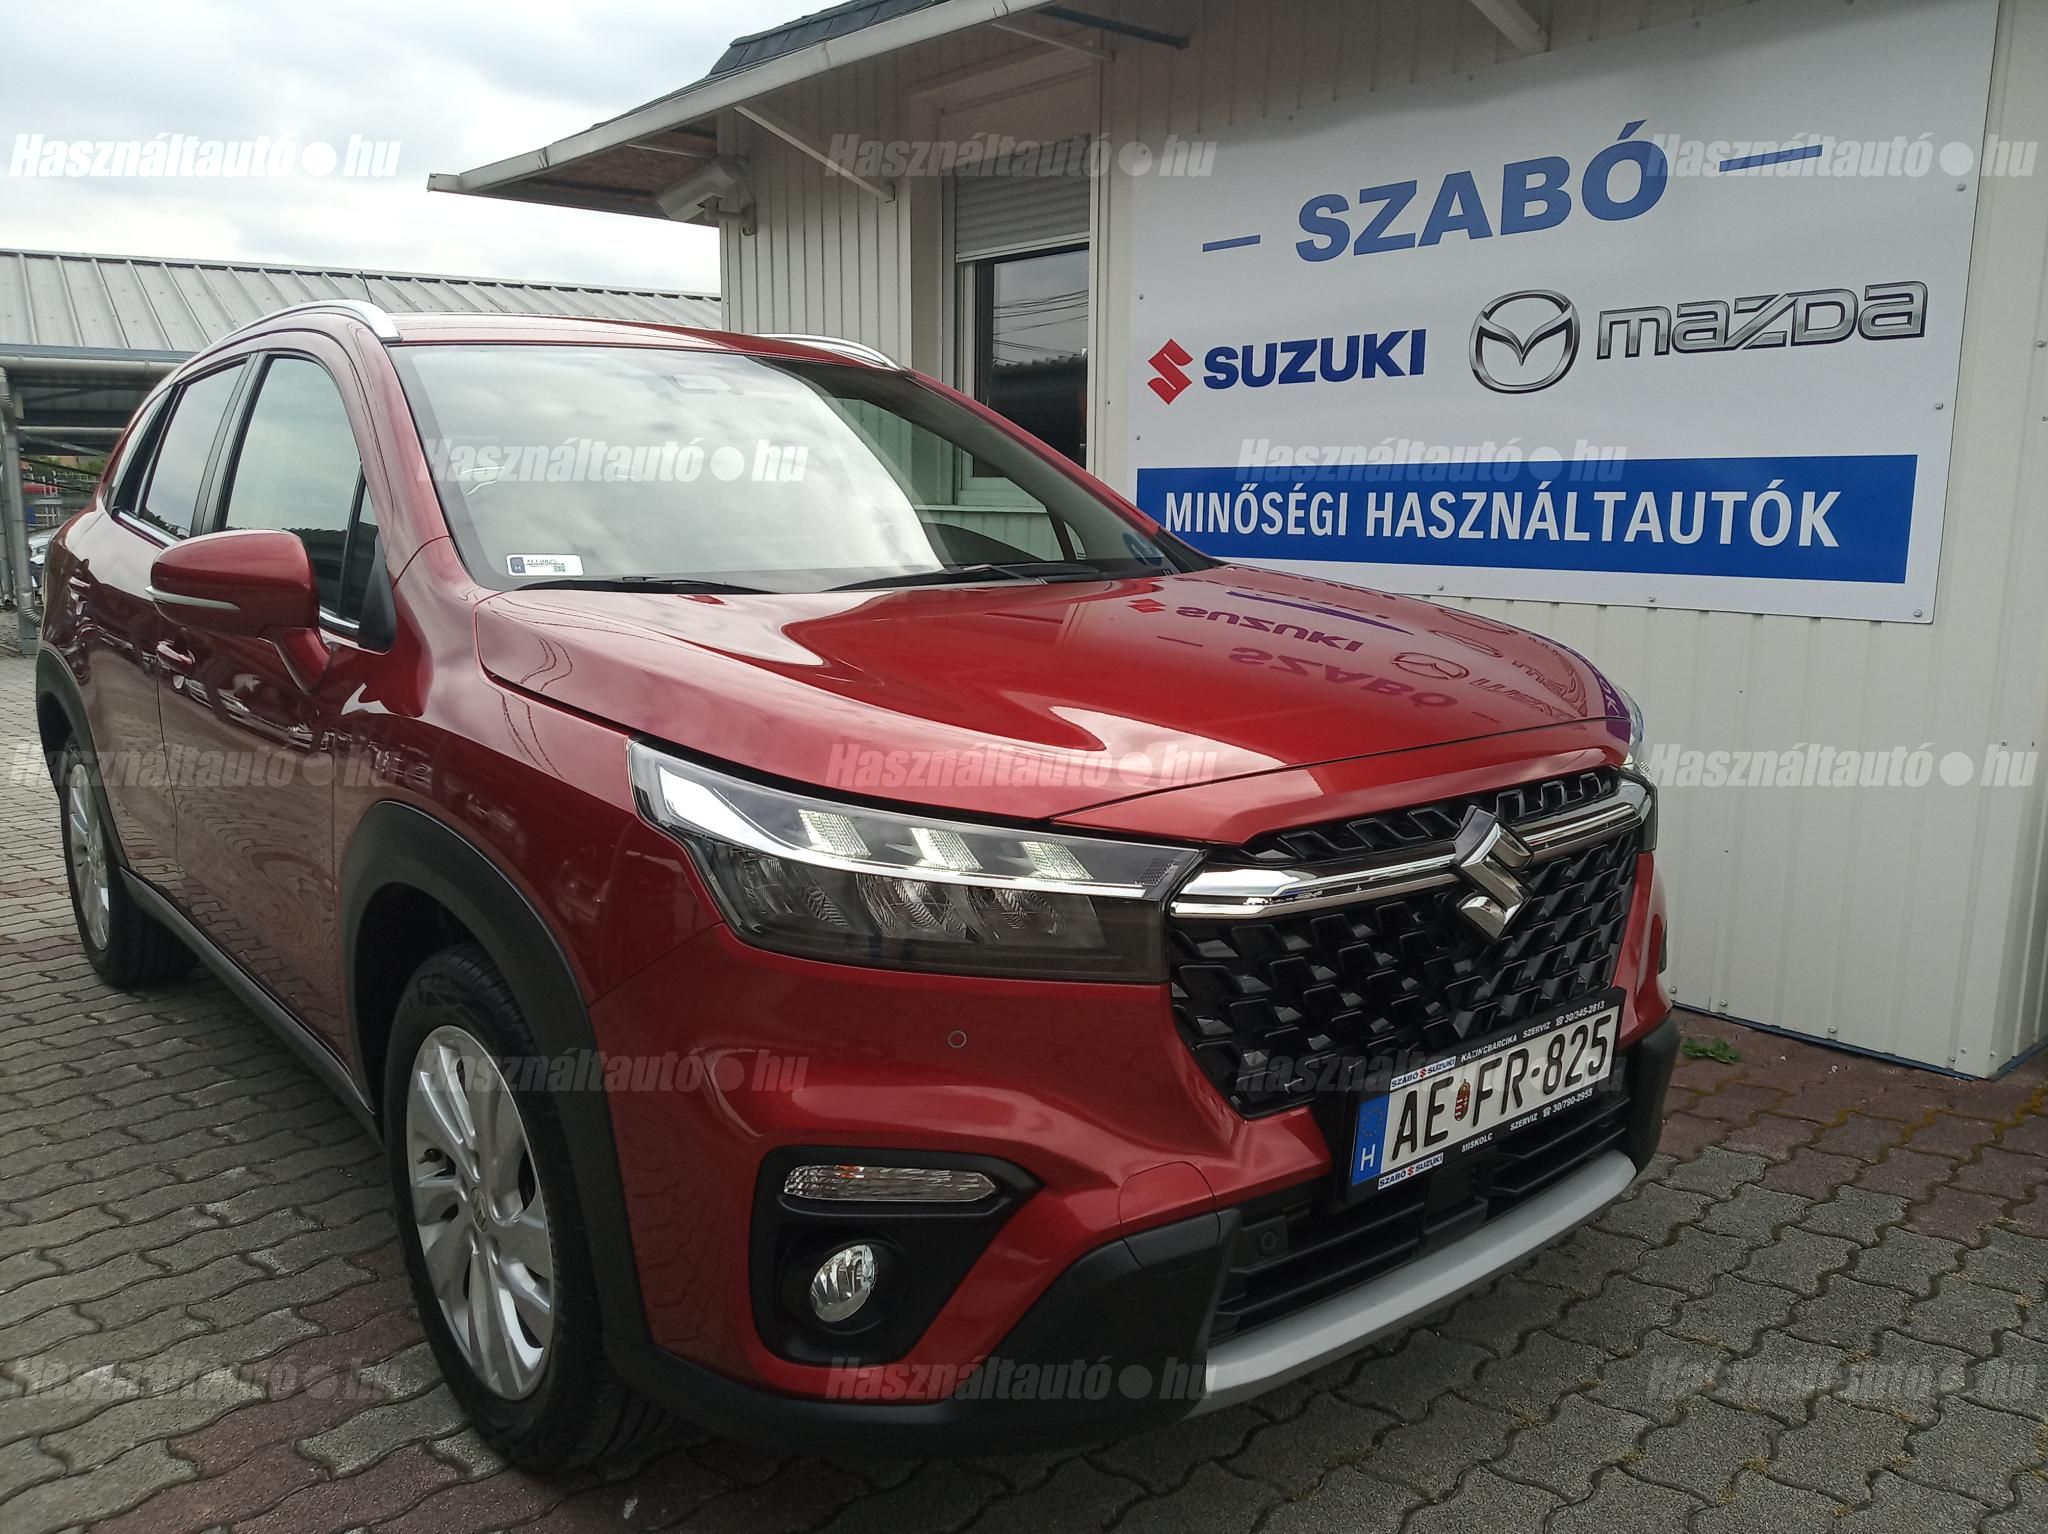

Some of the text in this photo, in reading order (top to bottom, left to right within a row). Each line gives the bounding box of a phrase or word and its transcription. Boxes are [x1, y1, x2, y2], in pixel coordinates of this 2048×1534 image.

[1296, 120, 1668, 262] SZABÓ
[1203, 328, 1427, 391] SUZUKI
[1164, 478, 1841, 549] MINŐSÉGI HASZNÁLTAUTÓK
[1522, 1021, 1552, 1039] SZERVIZ
[1391, 1076, 1455, 1162] AE
[1510, 1112, 1538, 1131] SZERVIZ
[1360, 1143, 1376, 1171] H
[1461, 1132, 1493, 1153] MISKOLC
